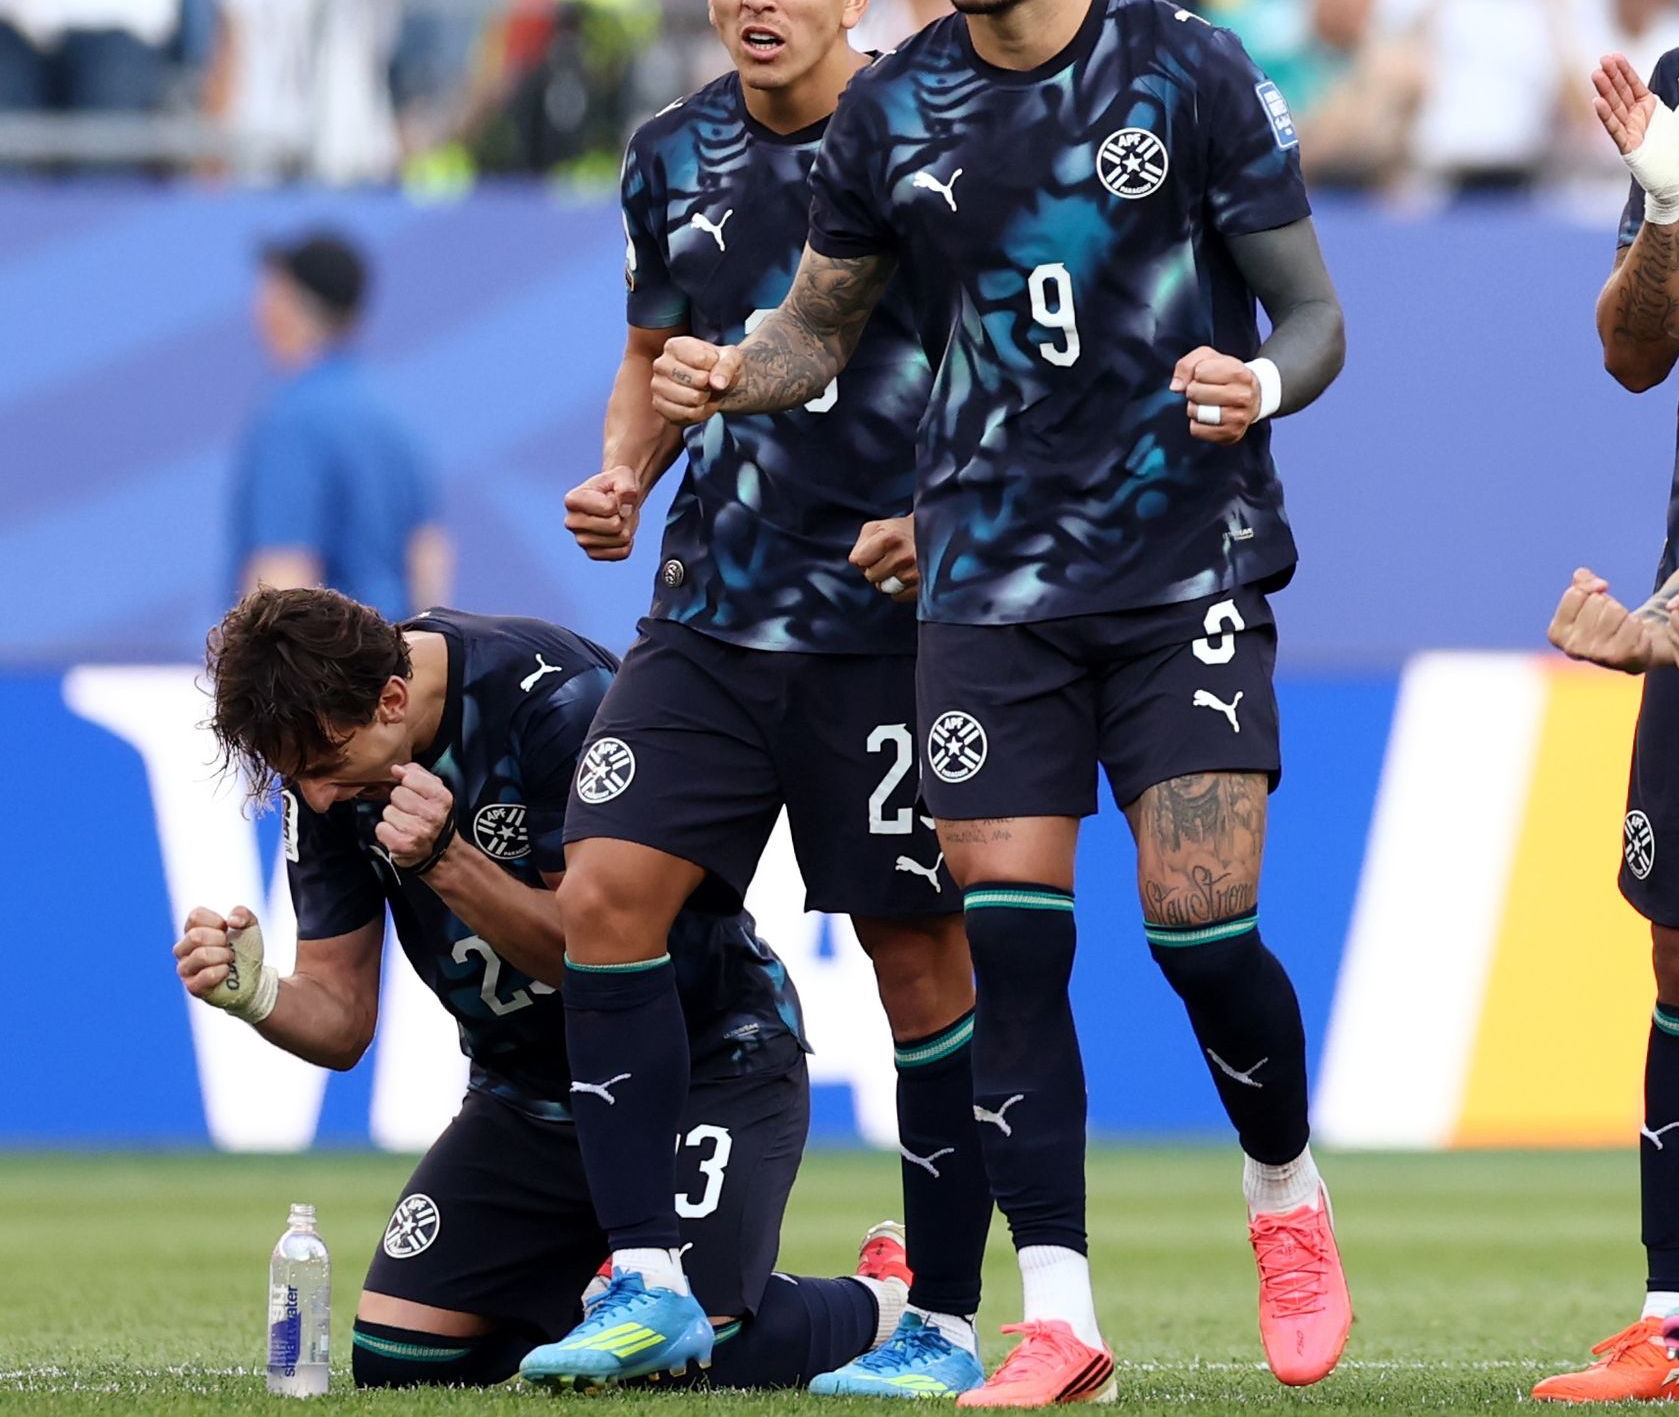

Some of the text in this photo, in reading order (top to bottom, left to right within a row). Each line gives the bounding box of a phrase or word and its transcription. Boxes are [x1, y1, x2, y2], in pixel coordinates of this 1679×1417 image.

[1118, 133, 1142, 147] APF
[1028, 263, 1079, 367] 9
[944, 717, 964, 730] APF
[867, 724, 937, 835] 2
[486, 808, 507, 821] APF
[674, 1124, 733, 1219] 3
